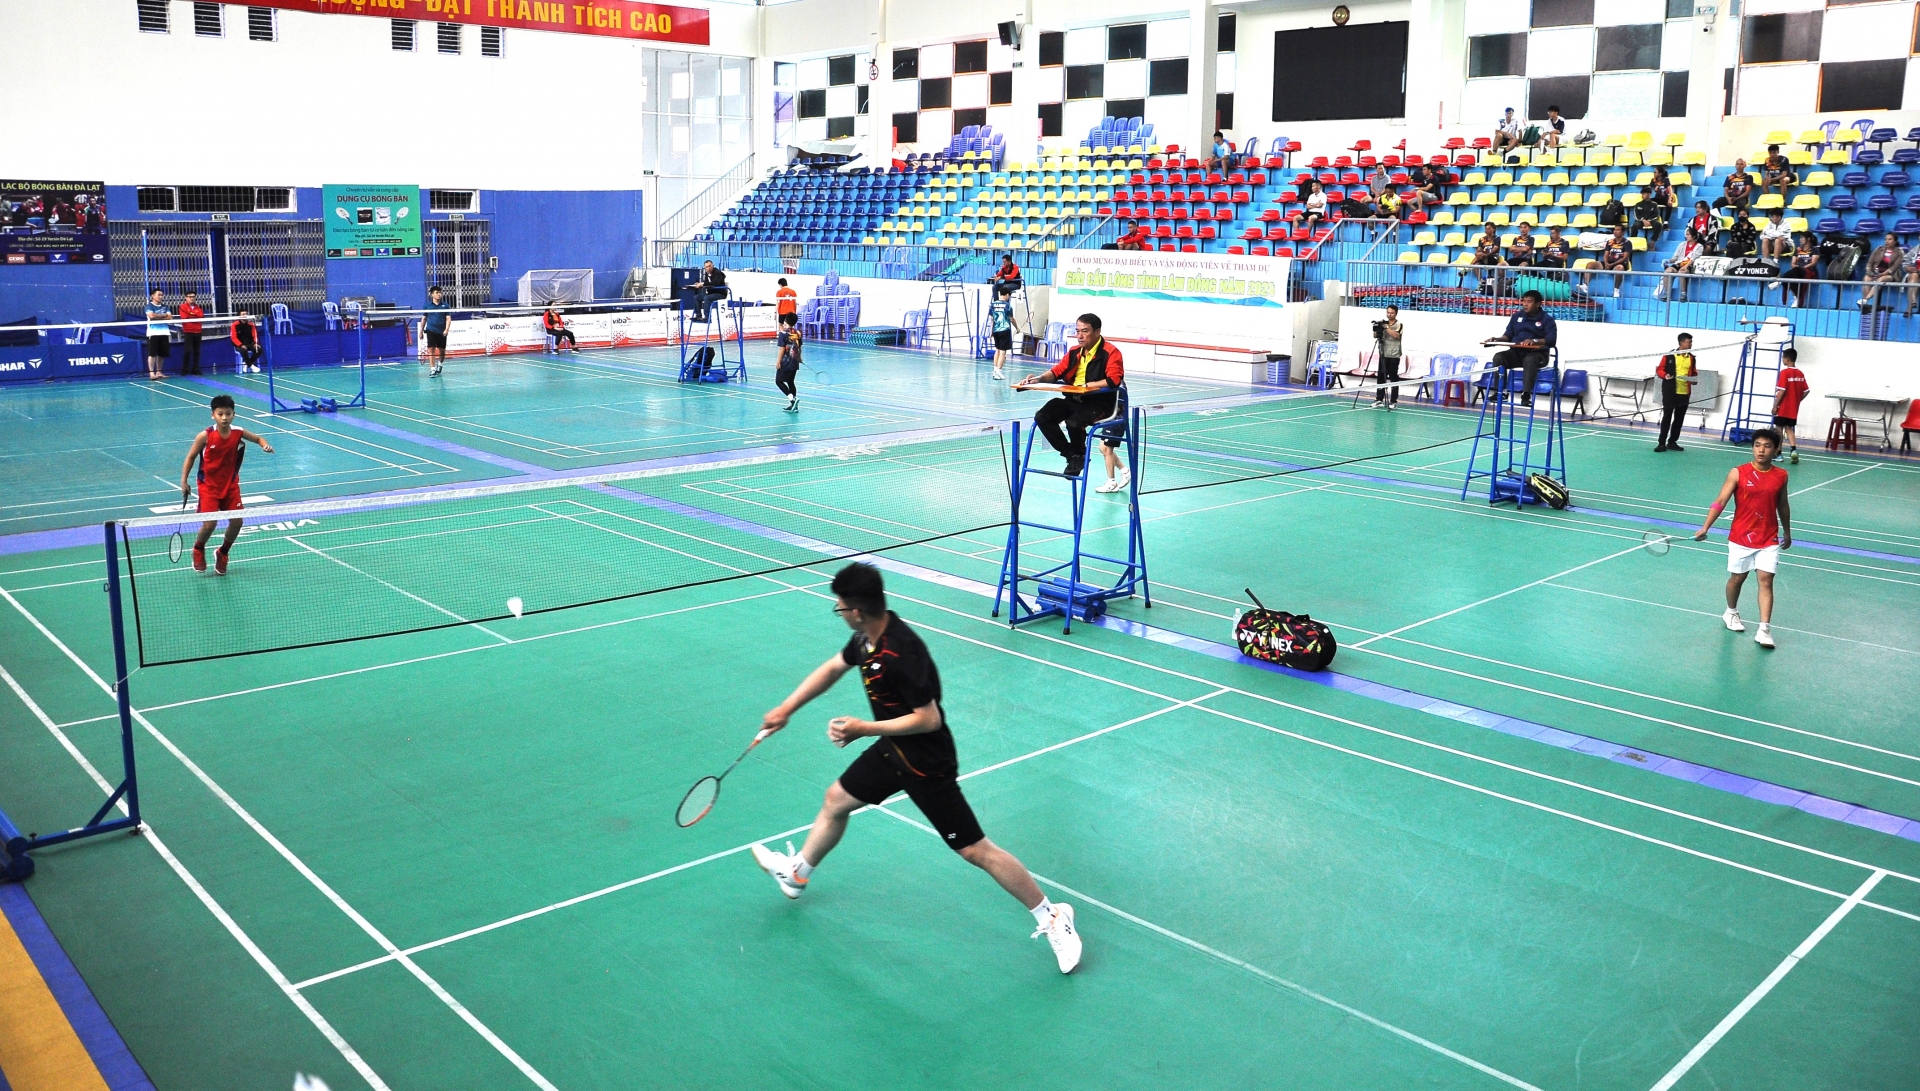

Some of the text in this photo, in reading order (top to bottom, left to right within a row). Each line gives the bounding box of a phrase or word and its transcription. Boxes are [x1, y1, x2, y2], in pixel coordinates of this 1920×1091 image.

[572, 2, 622, 29] TÍCH
[630, 11, 672, 34] CAO
[56, 183, 73, 191] BÀN
[337, 193, 408, 204] DỤNG CỤ BÓNG BÀN
[1072, 256, 1092, 264] CHÀO
[1233, 263, 1256, 272] THAM
[1746, 267, 1769, 275] YONEX
[1108, 270, 1135, 288] LÔNG
[1247, 280, 1276, 297] 2024
[68, 356, 109, 366] TIBHAR
[1257, 633, 1293, 653] YNEX
